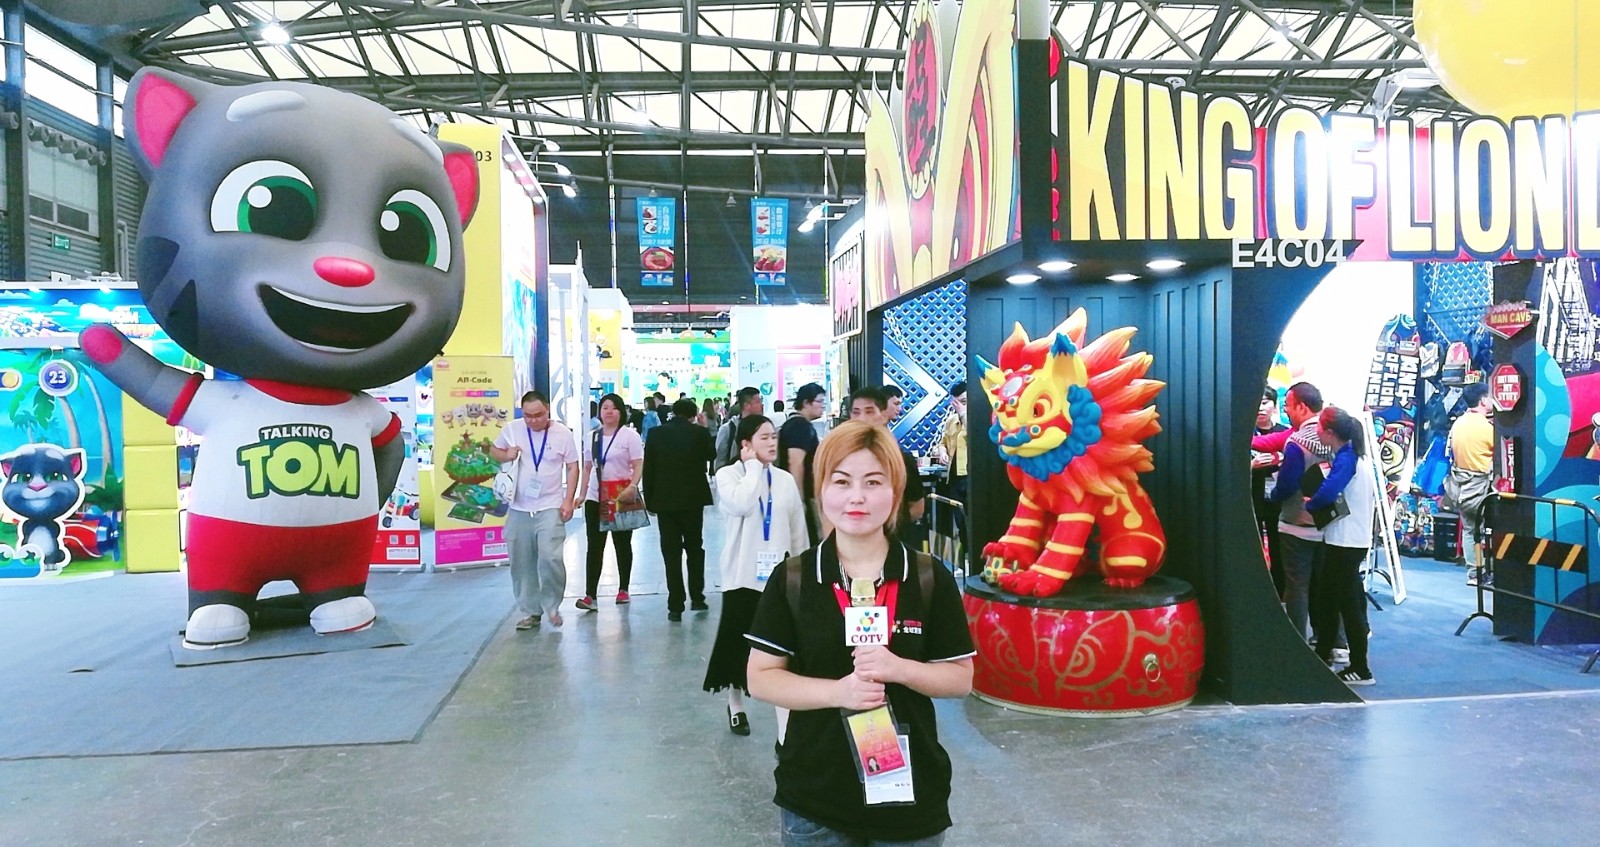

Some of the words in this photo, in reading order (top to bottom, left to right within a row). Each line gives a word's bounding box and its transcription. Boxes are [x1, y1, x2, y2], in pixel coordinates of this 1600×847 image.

[1067, 60, 1255, 240] KING
[1273, 106, 1375, 240] OF
[1389, 116, 1565, 252] LION
[1232, 237, 1347, 267] E4C04
[1491, 312, 1508, 324] MAN
[1510, 310, 1532, 322] CAVE
[48, 370, 67, 384] 23
[456, 376, 493, 384] AR-Code
[1366, 351, 1386, 407] DANCE
[1379, 372, 1399, 407] LION
[261, 425, 331, 440] TALKING
[241, 440, 358, 496] TOM
[1507, 443, 1515, 490] EXIT
[850, 634, 883, 644] COTV
